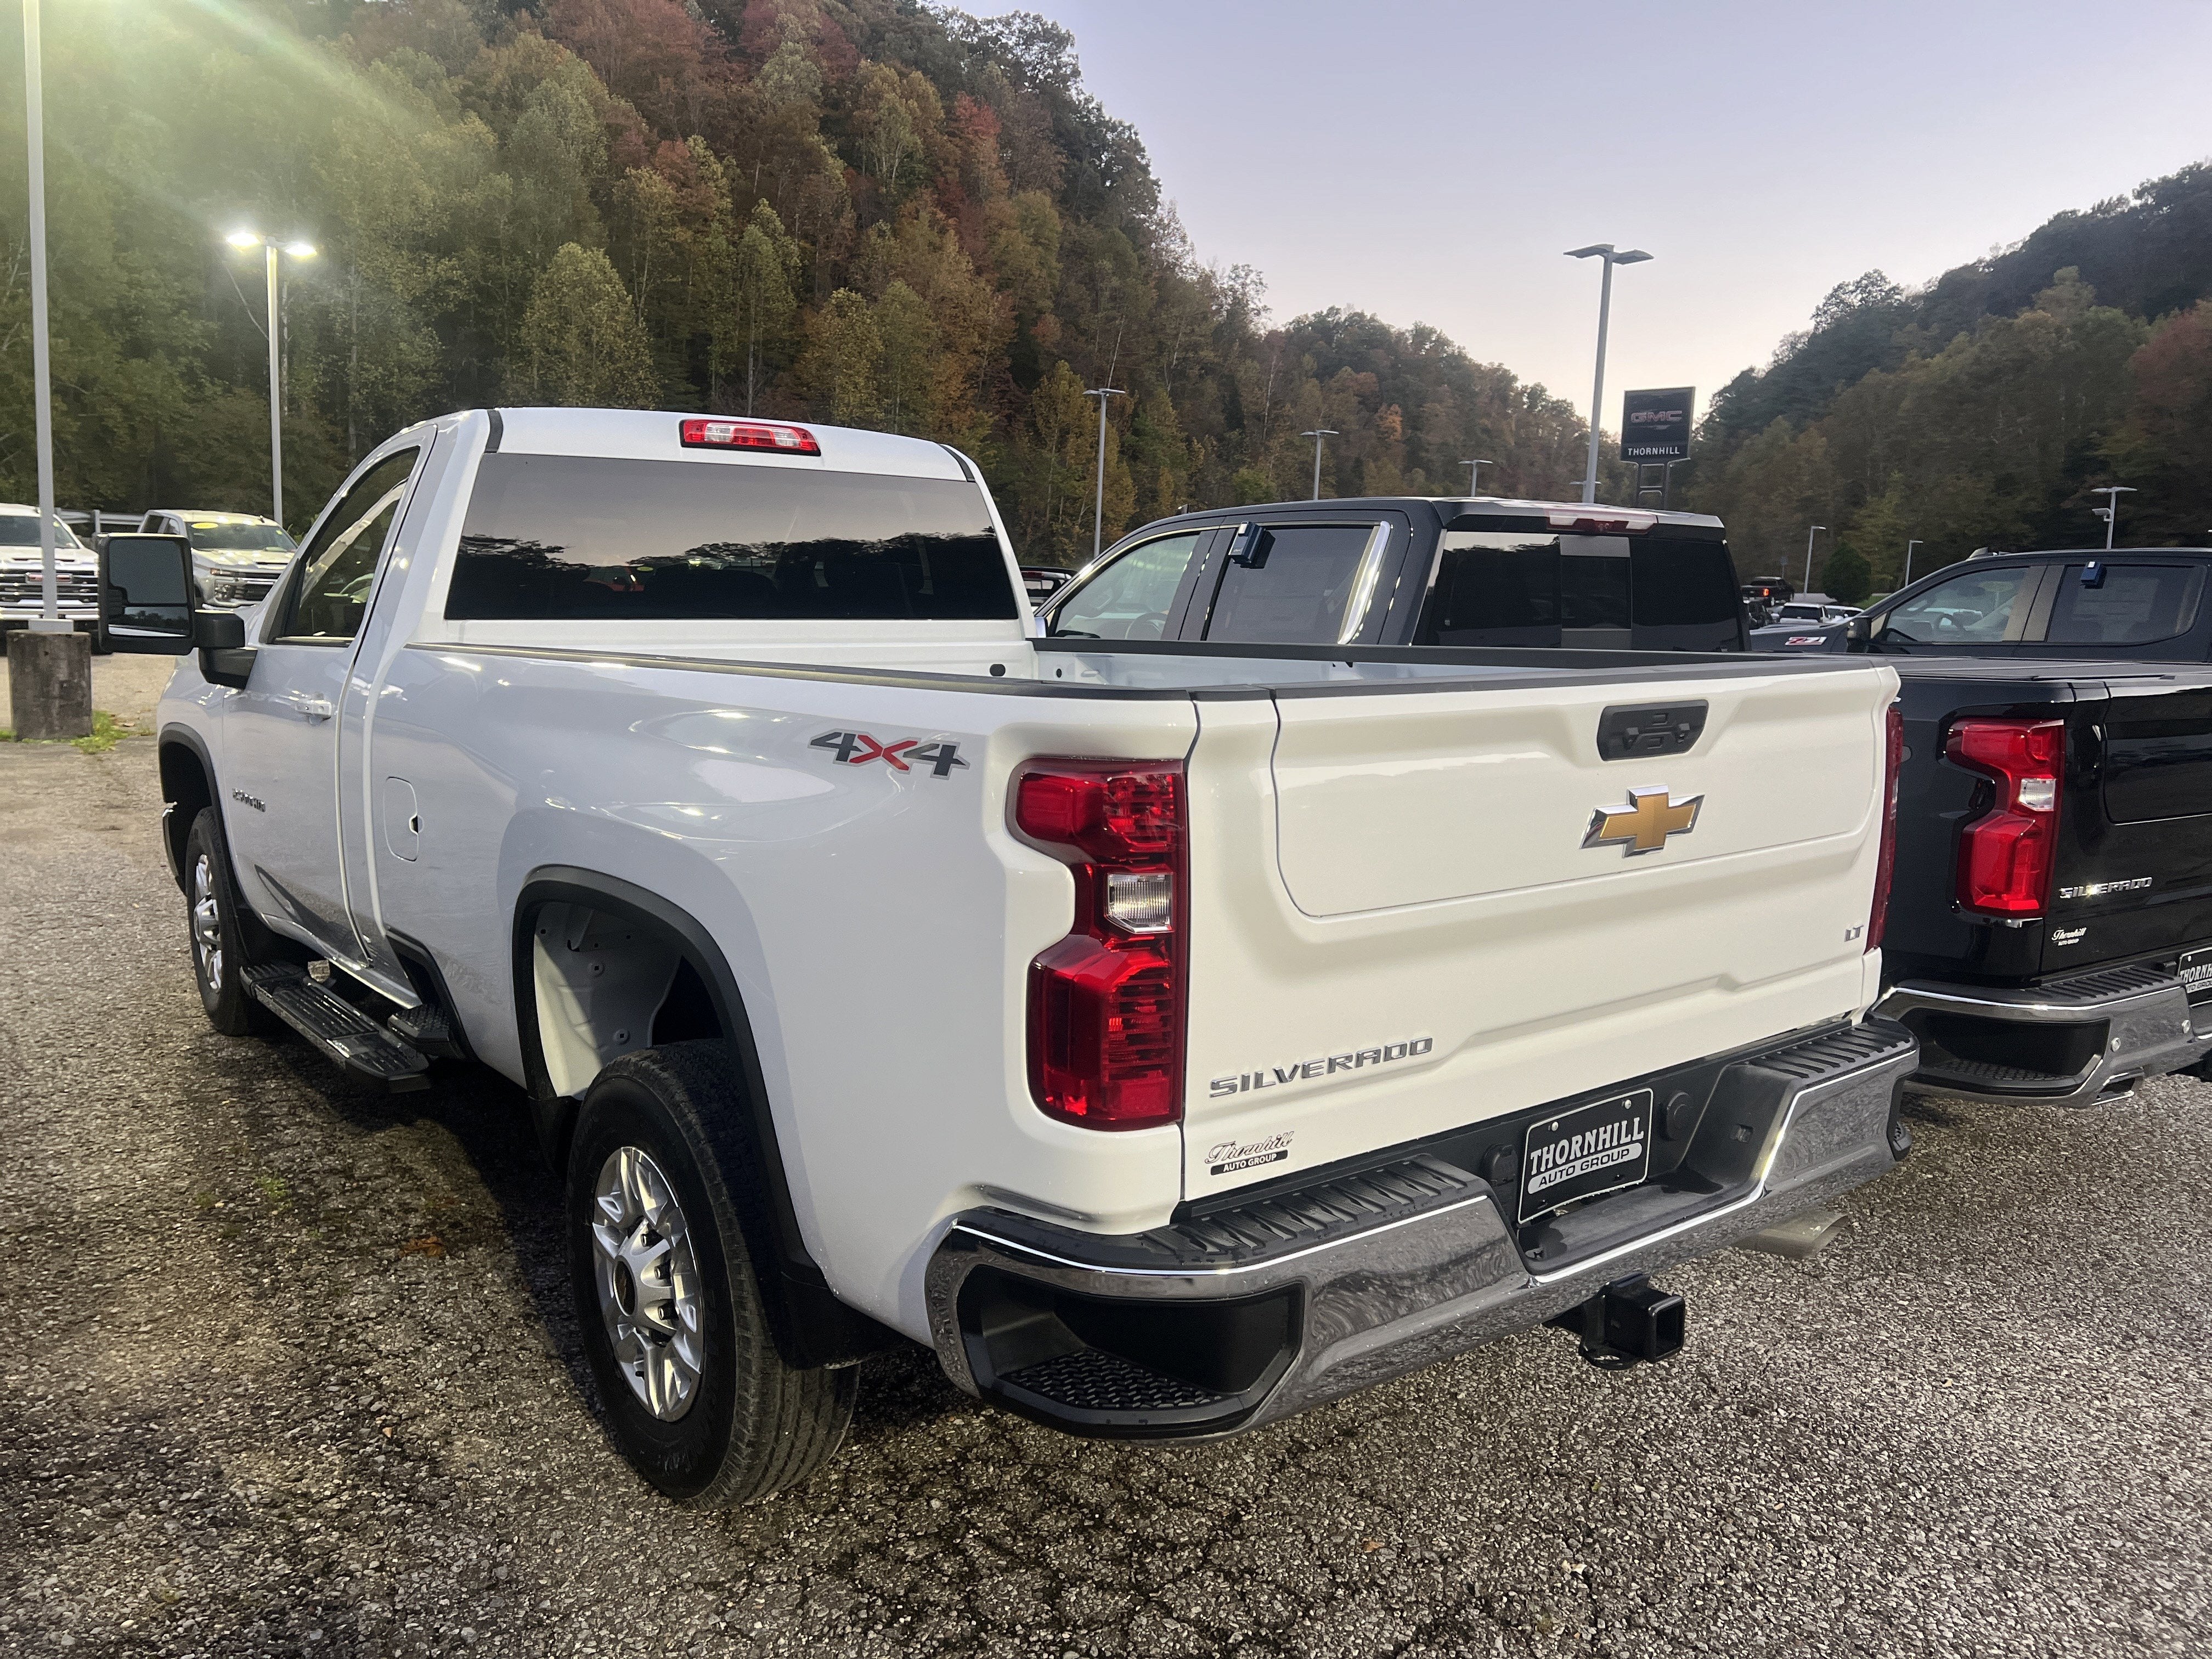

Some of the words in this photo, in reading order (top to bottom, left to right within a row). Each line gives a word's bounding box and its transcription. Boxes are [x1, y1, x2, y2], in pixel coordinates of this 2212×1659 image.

[1630, 410, 1683, 423] GMC
[1627, 446, 1680, 456] THORNHILL
[1785, 636, 1827, 646] Z71
[2059, 877, 2153, 899] SILVERADO
[1844, 924, 1864, 942] LT
[2051, 927, 2087, 940] Thornhill
[1209, 1036, 1433, 1098] SILVERADO
[1204, 1131, 1294, 1164] Thornhill
[1530, 1117, 1644, 1175] THORNHILL
[1223, 1160, 1247, 1172] AUTO
[1248, 1153, 1277, 1167] GROUP
[1538, 1165, 1576, 1188] AUTO
[1580, 1148, 1630, 1171] GROUP
